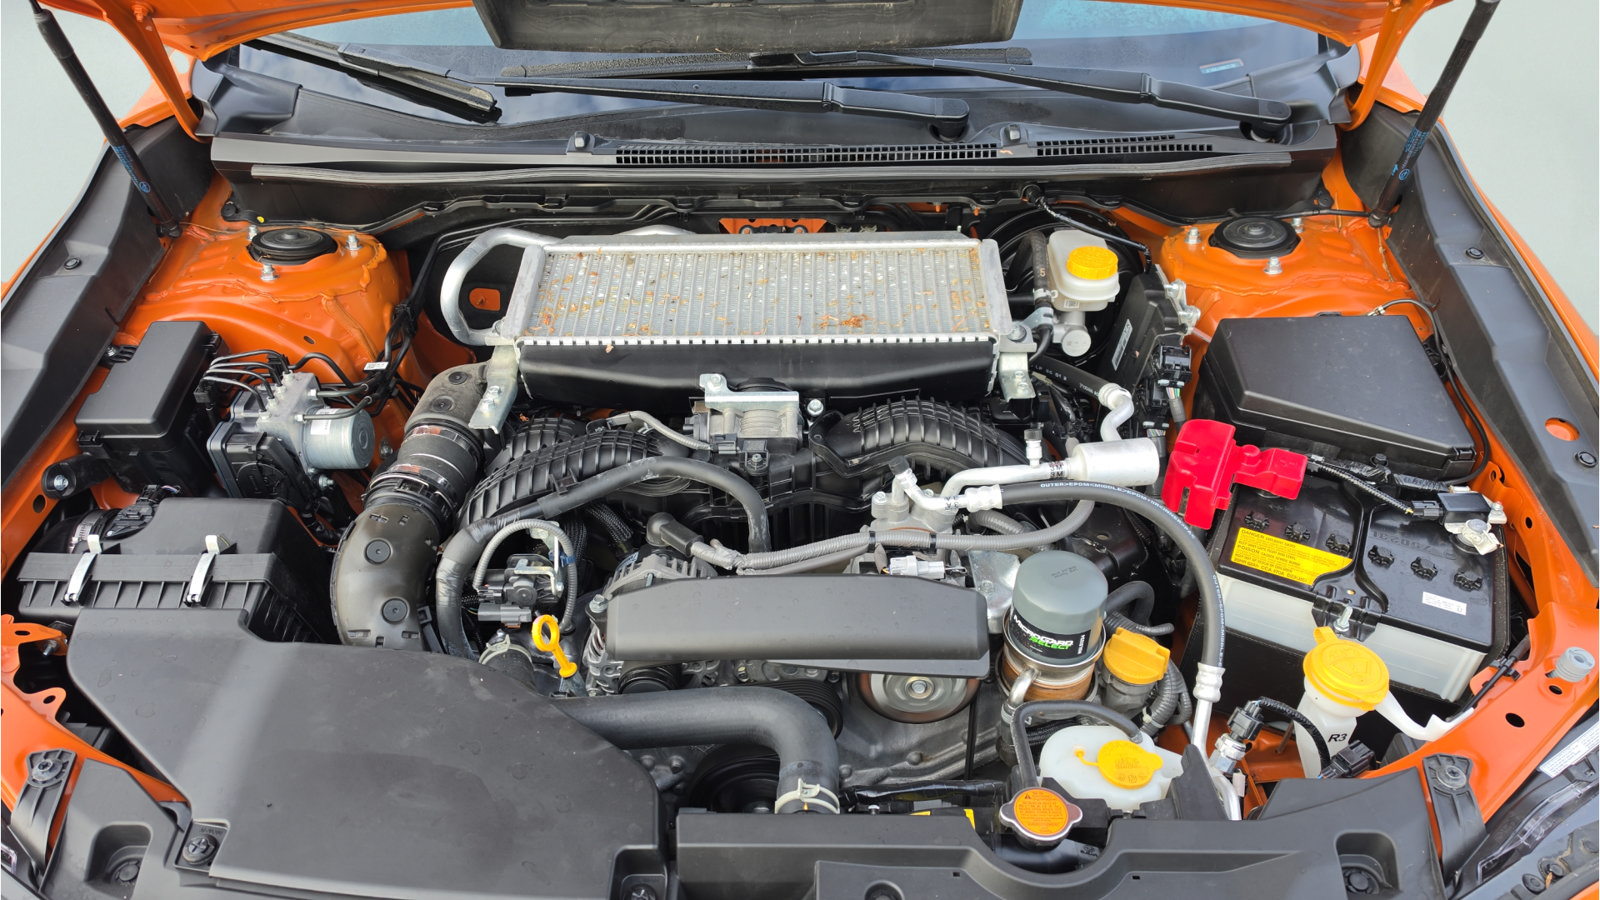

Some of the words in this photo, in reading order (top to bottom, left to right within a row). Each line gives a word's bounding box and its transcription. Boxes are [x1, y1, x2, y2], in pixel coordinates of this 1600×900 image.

[1040, 267, 1046, 277] 5
[1241, 529, 1265, 539] DANGER
[1237, 544, 1260, 554] POISON
[1013, 614, 1074, 646] MICROGARD
[1029, 635, 1071, 650] SELECT
[1328, 733, 1347, 743] R3
